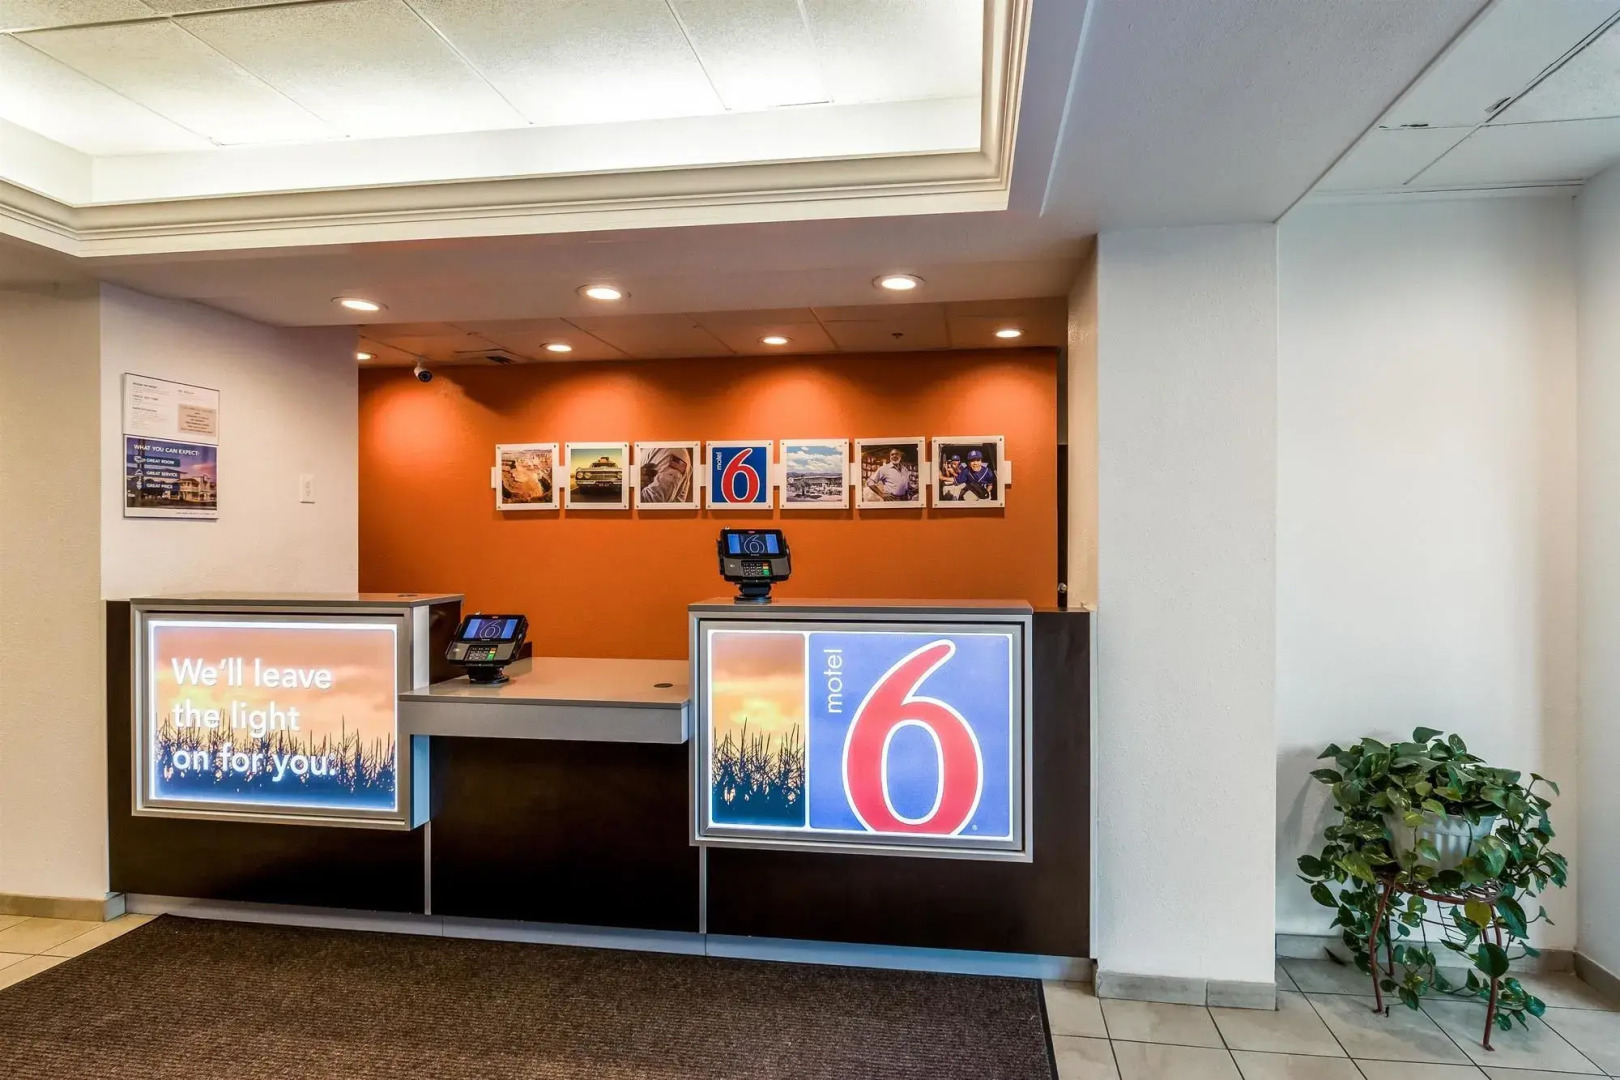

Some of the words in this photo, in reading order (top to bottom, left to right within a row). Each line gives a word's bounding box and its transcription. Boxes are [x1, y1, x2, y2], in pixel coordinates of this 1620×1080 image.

[721, 448, 760, 504] 6
[743, 534, 765, 554] 6
[479, 619, 501, 639] 6
[171, 657, 242, 687] We'll
[254, 657, 334, 689] leave
[172, 698, 220, 729] the
[231, 700, 301, 739] light
[823, 649, 843, 713] motel
[842, 639, 984, 836] 6
[172, 749, 209, 771] on
[220, 742, 264, 773] for
